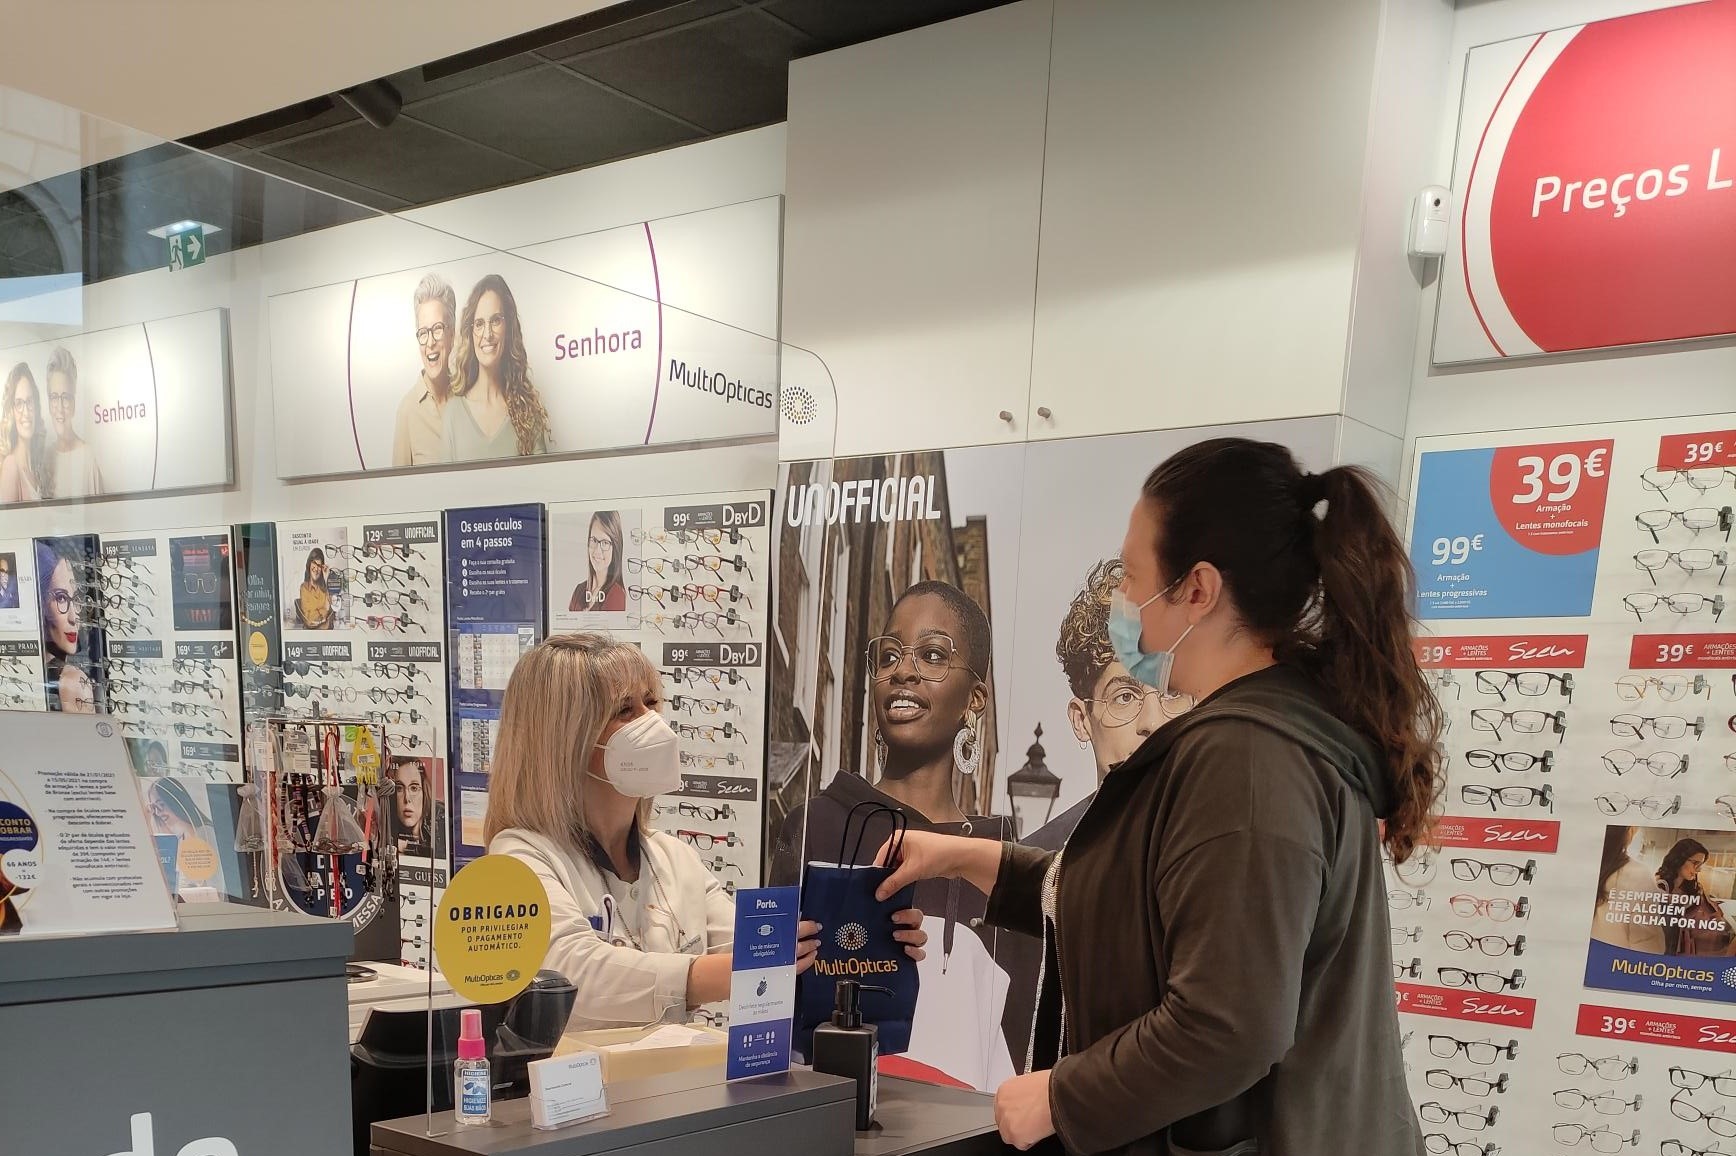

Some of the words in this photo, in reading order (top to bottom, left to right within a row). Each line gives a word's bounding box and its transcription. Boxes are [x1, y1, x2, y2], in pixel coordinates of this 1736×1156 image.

[1531, 163, 1690, 219] Preços
[554, 327, 642, 361] Senhora
[669, 358, 773, 409] MultiOpticas
[93, 399, 147, 425] Senhora
[1684, 441, 1723, 463] 39€
[1512, 446, 1608, 505] 39€
[1535, 503, 1572, 514] Armação
[460, 520, 472, 533] Os
[473, 519, 493, 532] seus
[494, 516, 523, 531] óculos
[673, 512, 691, 527] 99€
[1515, 521, 1541, 530] Lentes
[1542, 518, 1589, 529] monofocais
[460, 539, 475, 549] em
[476, 536, 482, 548] 4
[483, 535, 513, 550] passos
[1431, 532, 1485, 566] 99€
[1436, 573, 1470, 583] Armação
[1416, 590, 1440, 598] Lentes
[1441, 588, 1488, 600] progressivas
[671, 648, 689, 662] 99€
[1655, 643, 1694, 663] 39€
[756, 899, 778, 910] Porto.
[1618, 889, 1669, 903] SEMPRE
[1671, 894, 1701, 906] BOM
[449, 903, 539, 922] OBRIGADO
[1608, 900, 1630, 912] TER
[1632, 901, 1686, 916] ALGUÉM
[461, 926, 477, 934] POR
[480, 923, 529, 933] PRIVILEGIAR
[1605, 912, 1631, 924] QUE
[1633, 914, 1667, 927] OLHA
[1669, 917, 1696, 929] POR
[1698, 917, 1726, 931] NÓS
[467, 935, 472, 943] O
[475, 932, 523, 942] PAGAMENTO
[814, 958, 898, 977] MultiOpticas
[1612, 958, 1715, 982] MultiOpticas
[464, 974, 504, 984] MultiOpticas
[1651, 979, 1664, 987] Olha
[1600, 1015, 1637, 1034] 39€
[1645, 1020, 1677, 1029] ARMAÇÕES
[1652, 1026, 1675, 1034] LENTES
